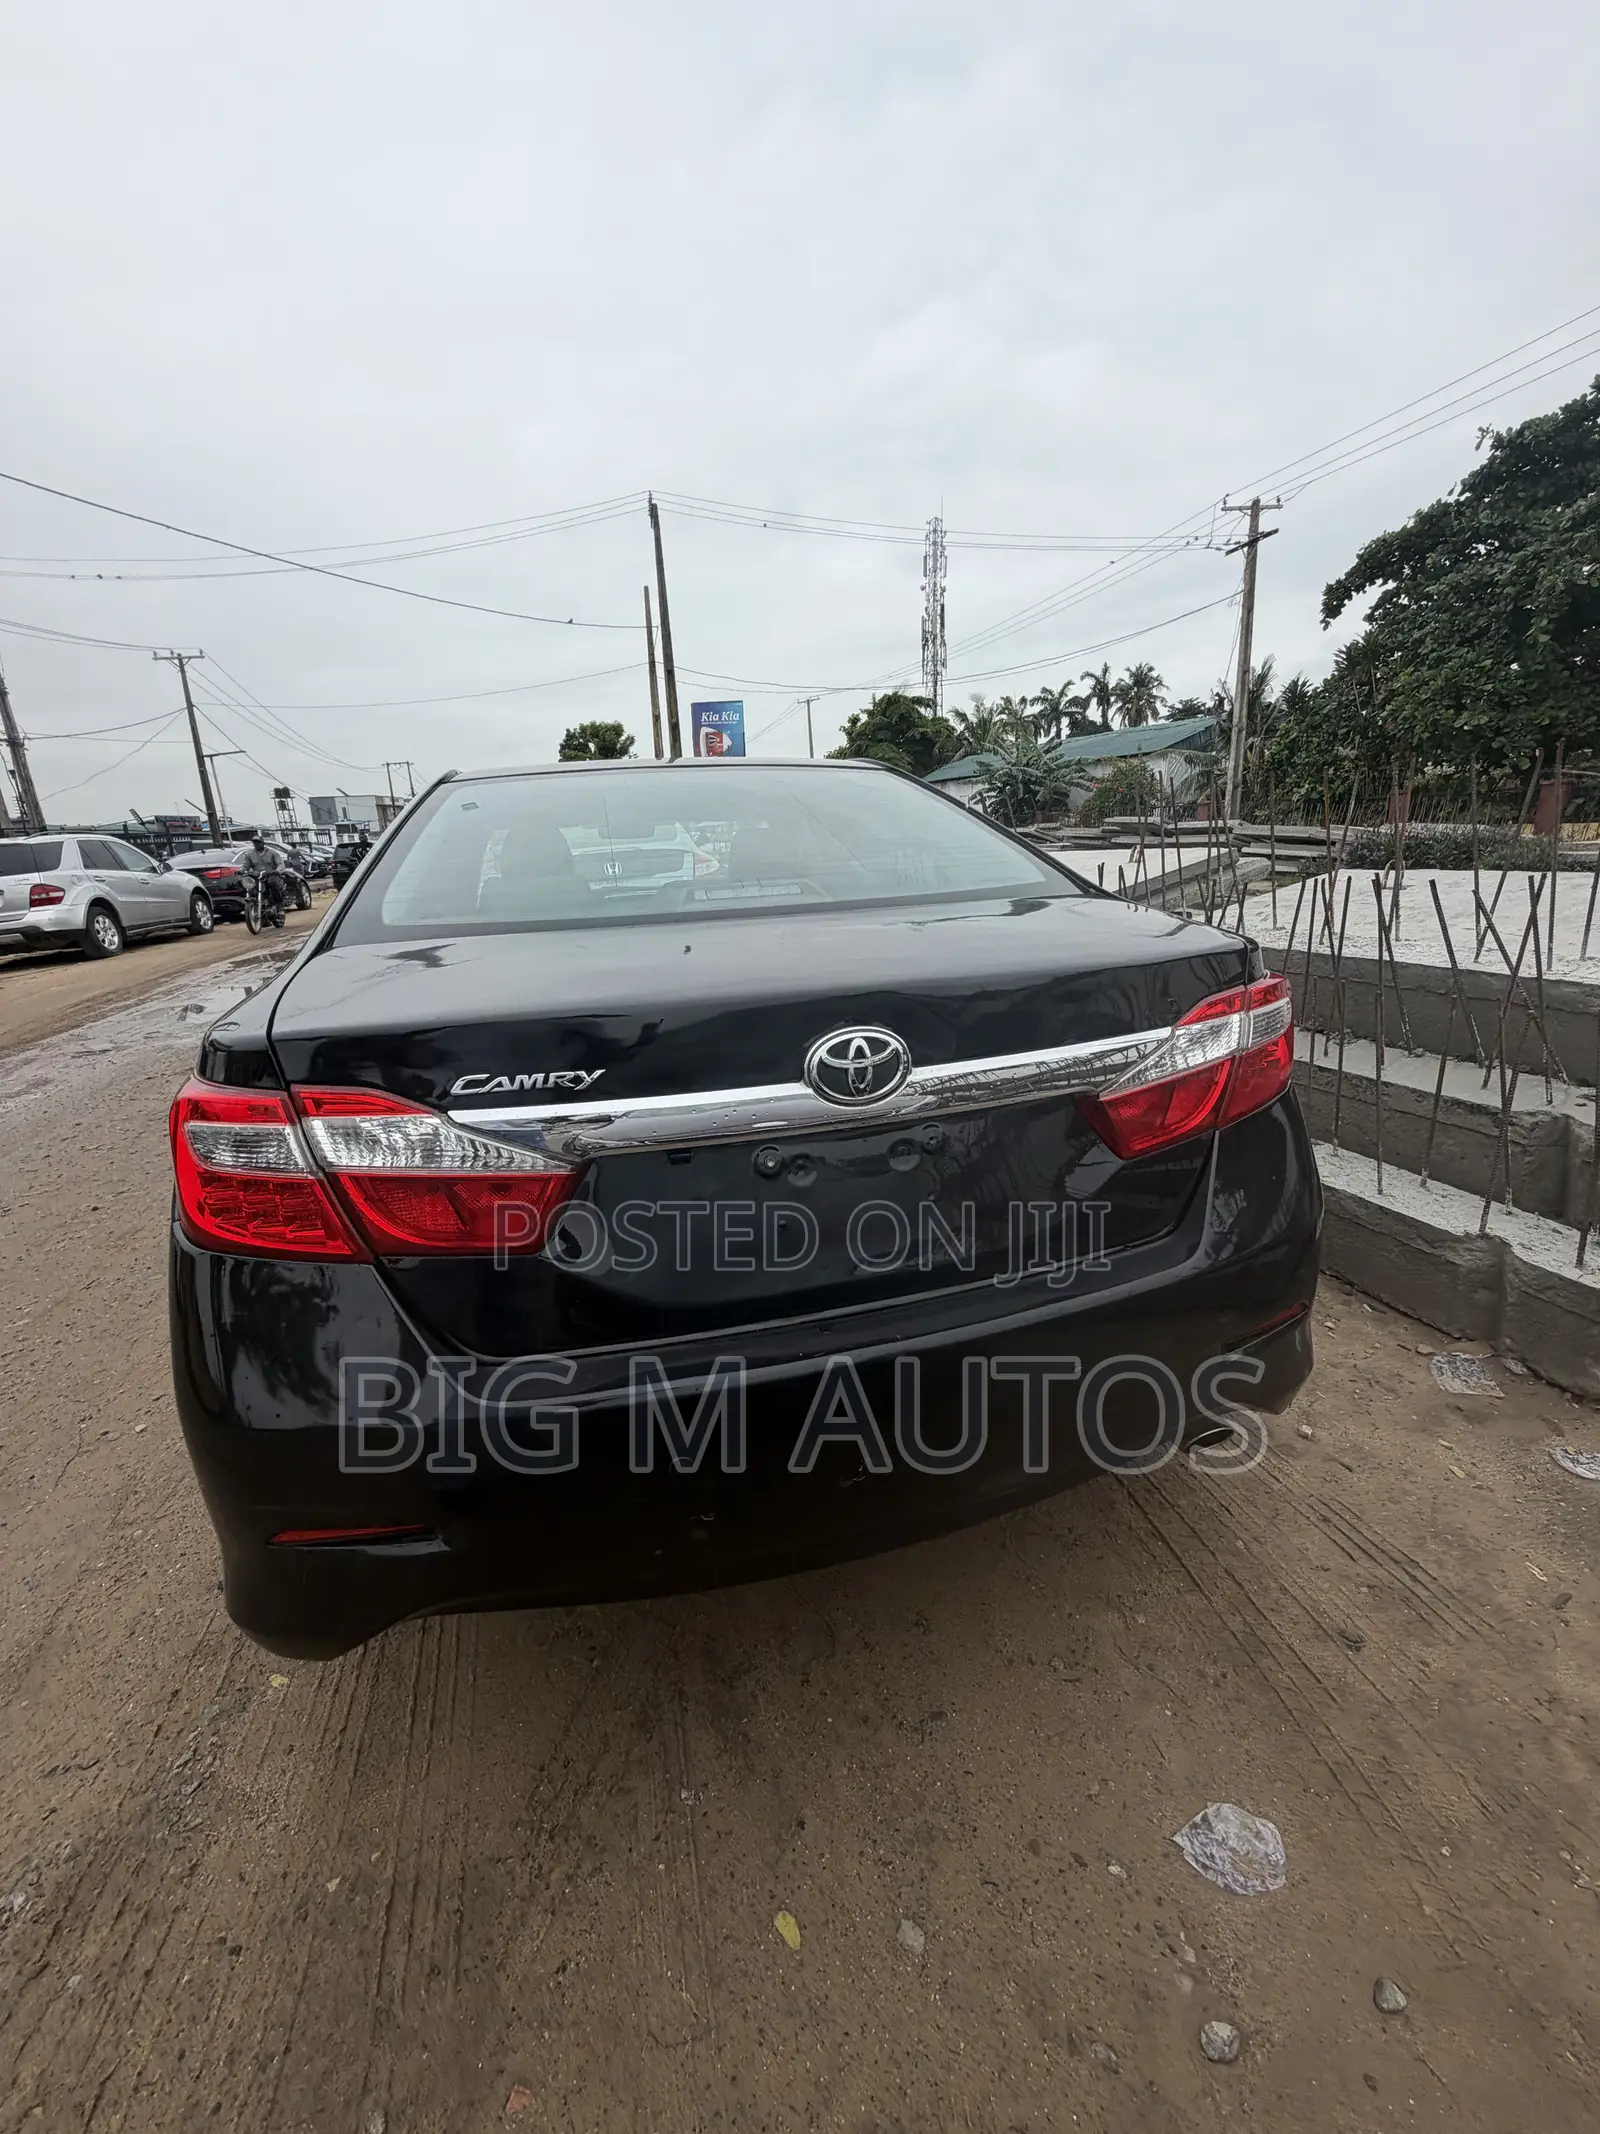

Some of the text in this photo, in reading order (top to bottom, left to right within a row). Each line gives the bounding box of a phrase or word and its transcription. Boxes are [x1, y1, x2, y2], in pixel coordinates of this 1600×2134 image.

[701, 710, 740, 722] Kia Kia
[450, 1069, 606, 1096] CAMRY
